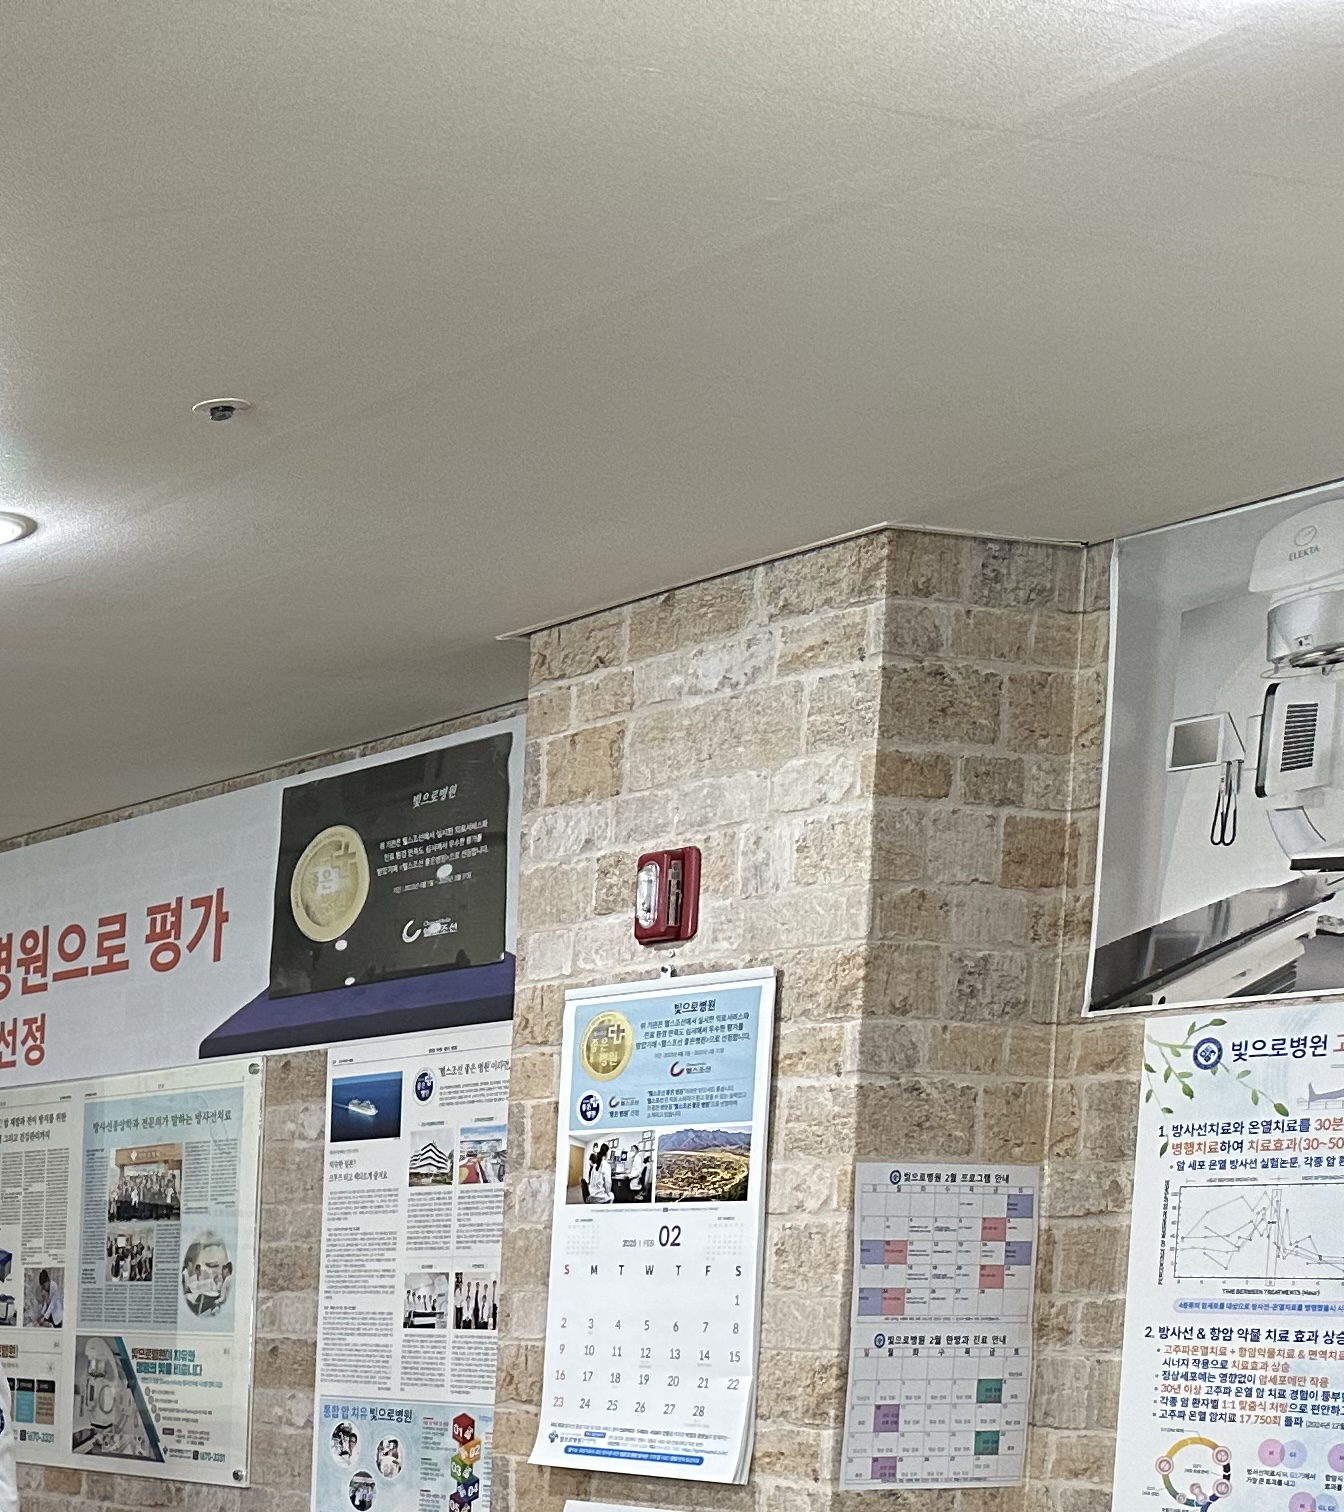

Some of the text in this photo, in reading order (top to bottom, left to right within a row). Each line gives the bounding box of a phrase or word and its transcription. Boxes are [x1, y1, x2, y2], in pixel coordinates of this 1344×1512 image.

[1288, 545, 1320, 561] ELEKTA
[145, 888, 229, 972] 평가
[674, 999, 716, 1014] 빛으로병원
[1231, 1034, 1328, 1062] 빛으로병원
[92, 1110, 232, 1134] 방사선종양학과 전문의가 말하는 방사선치료
[1158, 1116, 1344, 1138] 1. 방사선치료와 온열치료를 30분
[1172, 1140, 1243, 1155] 병행치료하여
[1188, 1160, 1205, 1170] 세포
[1208, 1159, 1227, 1170] 온열
[1230, 1158, 1257, 1169] 방사선
[1304, 1156, 1323, 1168] 각종
[904, 1172, 1009, 1184] 빛으로병원 2월 프로그램 안내
[659, 1225, 681, 1247] 02
[564, 1264, 741, 1276] S M T W T F S
[734, 1295, 740, 1305] 1
[561, 1318, 739, 1334] 2 3 4 5 6 7 8
[887, 1335, 925, 1345] 빛으로병원
[929, 1335, 941, 1345] 2월
[974, 1335, 988, 1345] 진료
[992, 1335, 1006, 1344] 안내
[1145, 1326, 1155, 1338] 2.
[1159, 1326, 1193, 1340] 방사선
[1197, 1328, 1206, 1339] &
[1210, 1327, 1233, 1342] 항암
[1237, 1329, 1261, 1342] 약물
[1265, 1329, 1289, 1342] 치료
[1293, 1330, 1318, 1343] 효과
[1163, 1345, 1227, 1357] 고주파온열치료
[1162, 1371, 1216, 1382] 정상세포에는
[1219, 1373, 1256, 1385] 영향없이
[1259, 1374, 1306, 1386] 암세포에만
[323, 1404, 412, 1423] 통합 암 치유 빛으로병원
[553, 1397, 705, 1417] 23 24 25 26 27 28
[454, 1424, 463, 1434] 01
[470, 1446, 480, 1457] 02
[451, 1464, 461, 1477] 03
[468, 1484, 479, 1497] 04
